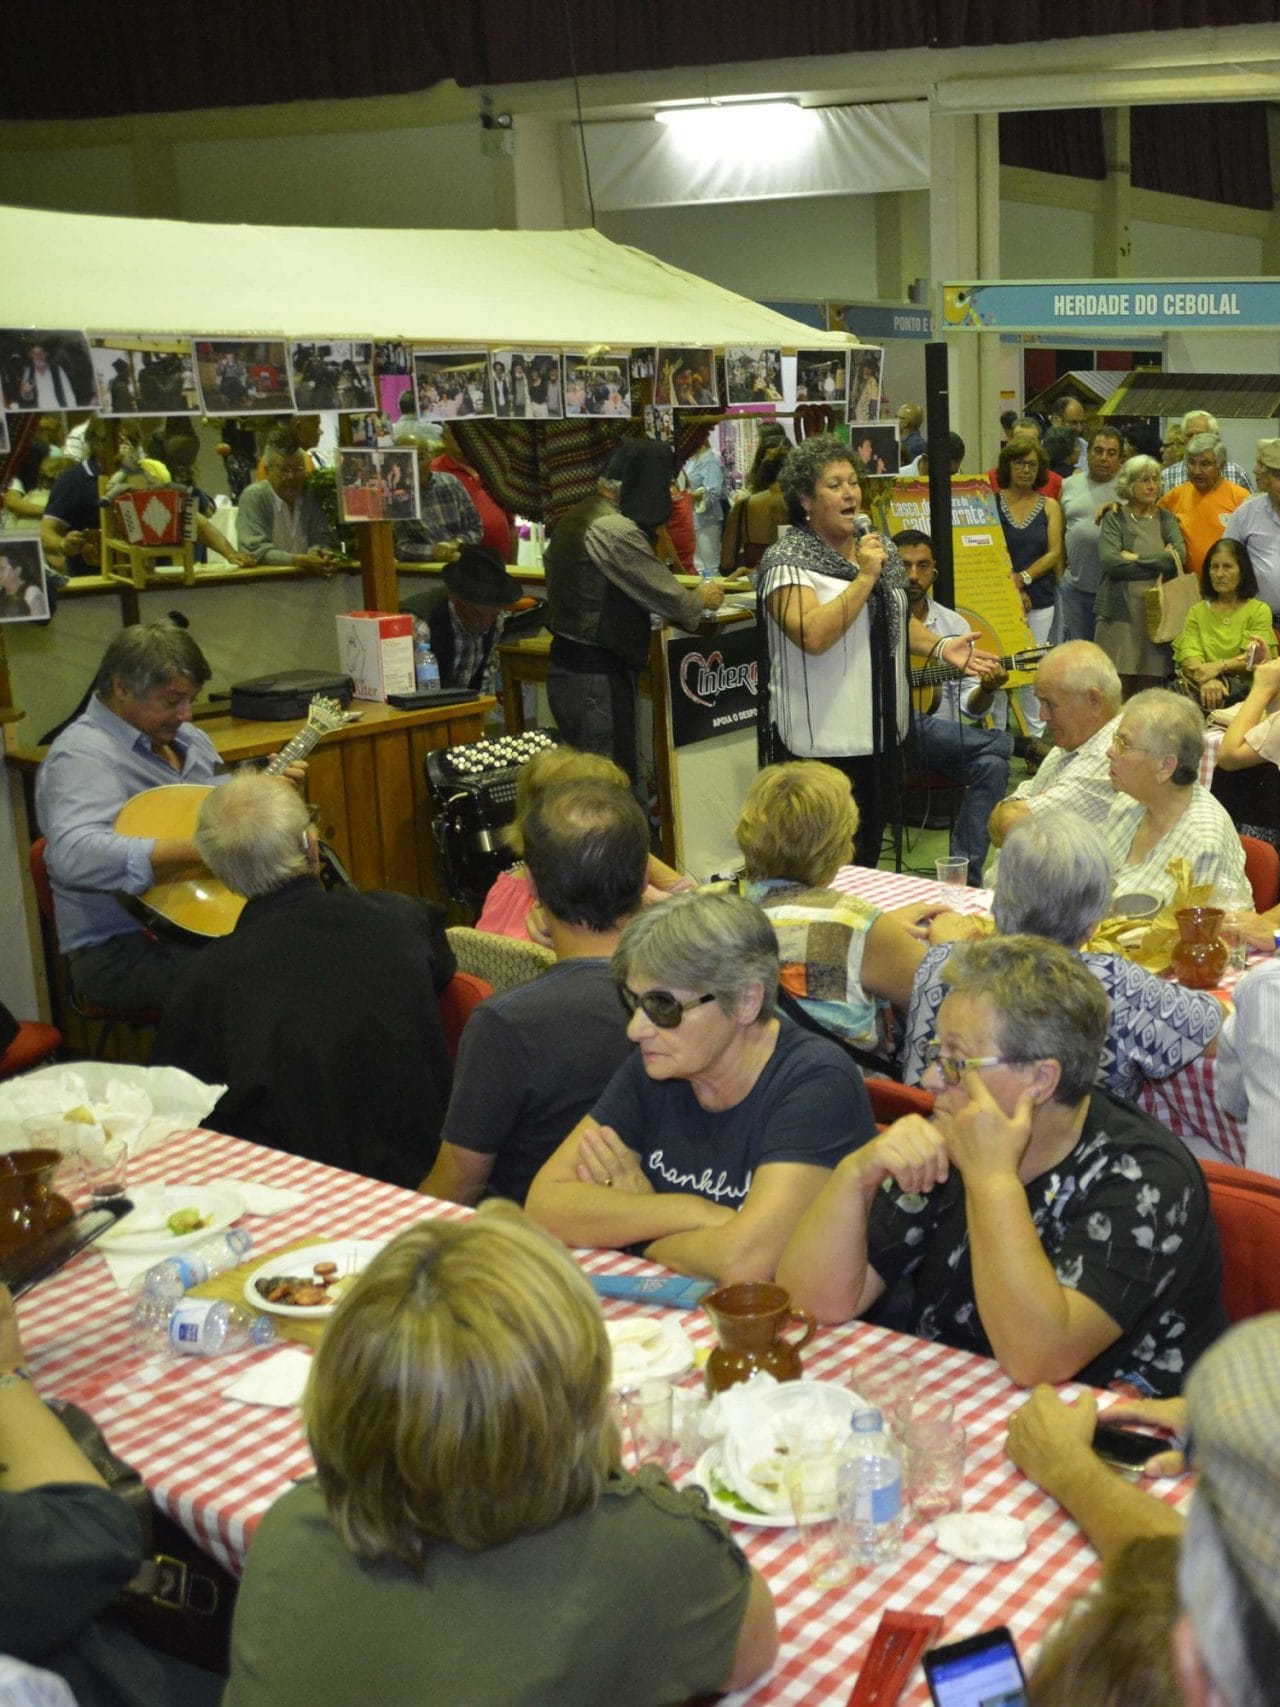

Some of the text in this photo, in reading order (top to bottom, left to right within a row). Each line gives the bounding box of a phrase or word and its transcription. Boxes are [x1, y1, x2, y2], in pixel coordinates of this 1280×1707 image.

[1054, 293, 1241, 316] HERDADE DO CEBOLAL
[893, 316, 929, 332] PONTO E
[890, 500, 920, 517] tasca
[712, 708, 759, 728] APOIA O DESPO
